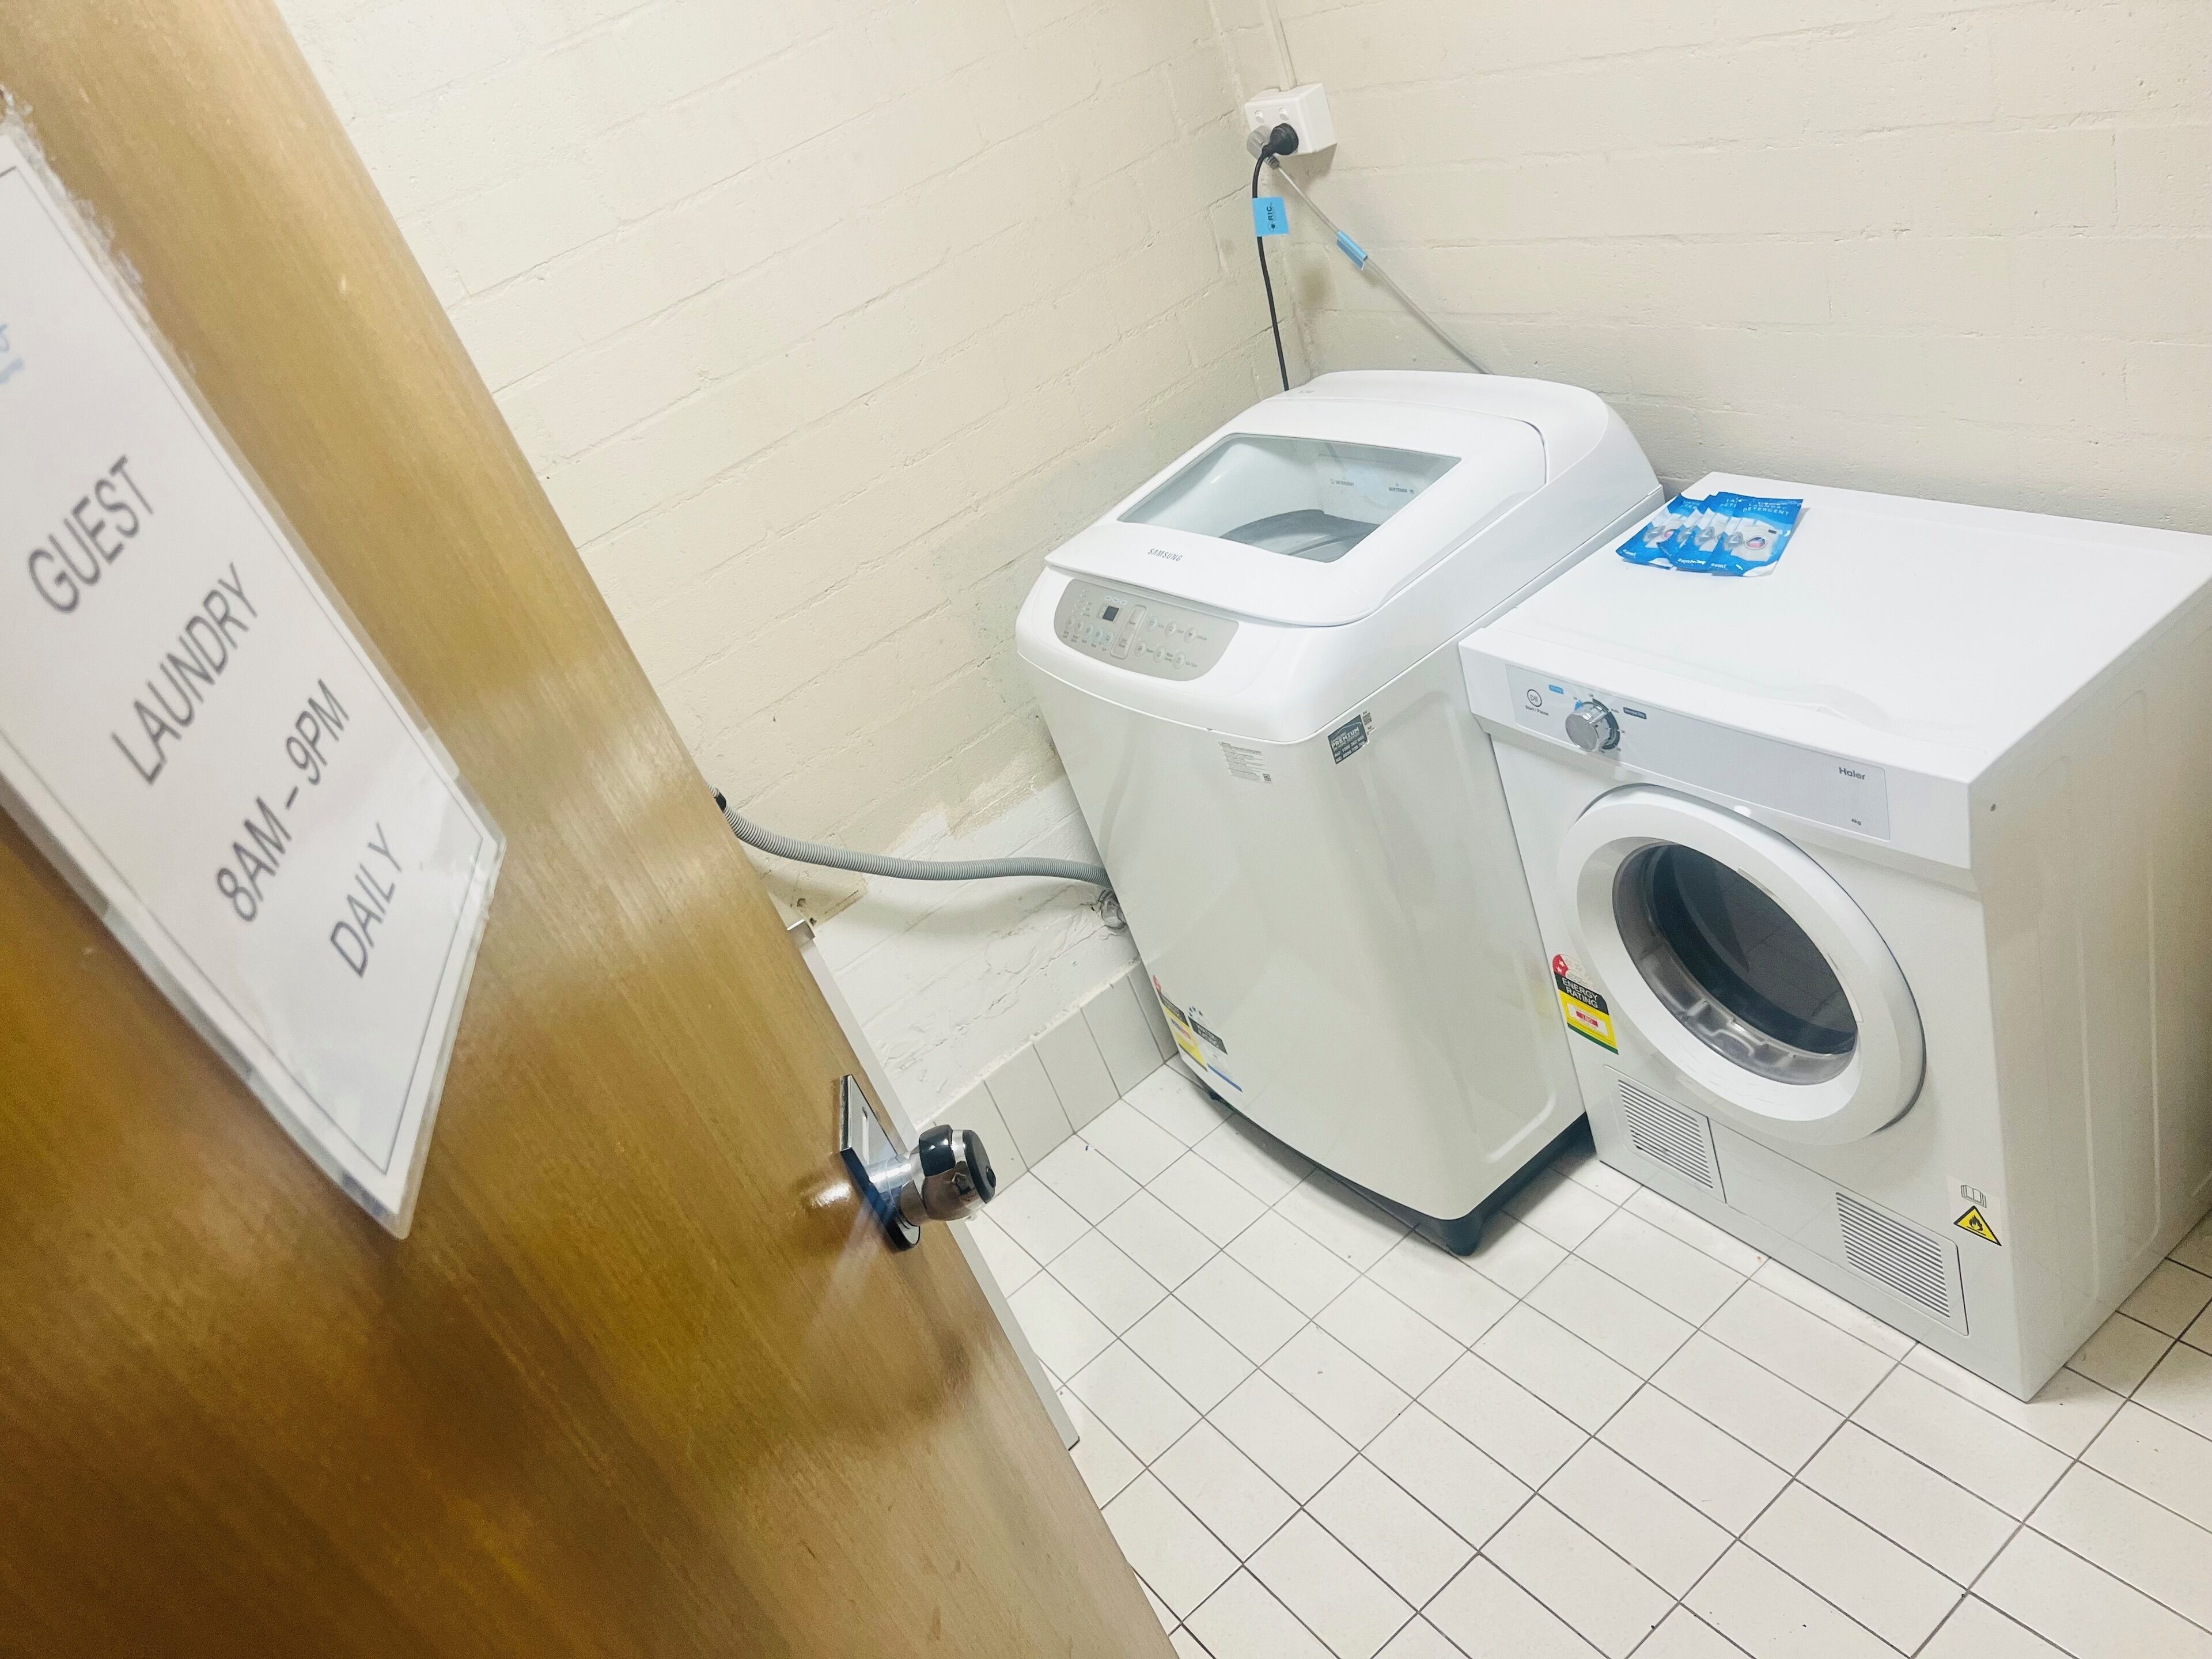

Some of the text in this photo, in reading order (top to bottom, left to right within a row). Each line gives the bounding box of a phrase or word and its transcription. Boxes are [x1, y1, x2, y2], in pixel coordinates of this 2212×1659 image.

[1743, 506, 1789, 516] DETERGENT
[28, 454, 153, 613] GUEST
[1147, 548, 1183, 562] SAMSUNG
[111, 562, 258, 786] LAUNDRY
[1331, 726, 1359, 748] PREMIUM
[1839, 767, 1866, 780] Haier
[217, 796, 292, 923] 8AM
[286, 678, 350, 785] 9PM
[331, 821, 402, 978] DAILY
[1562, 978, 1598, 1001] ENERGY
[1566, 987, 1599, 1009] RATING
